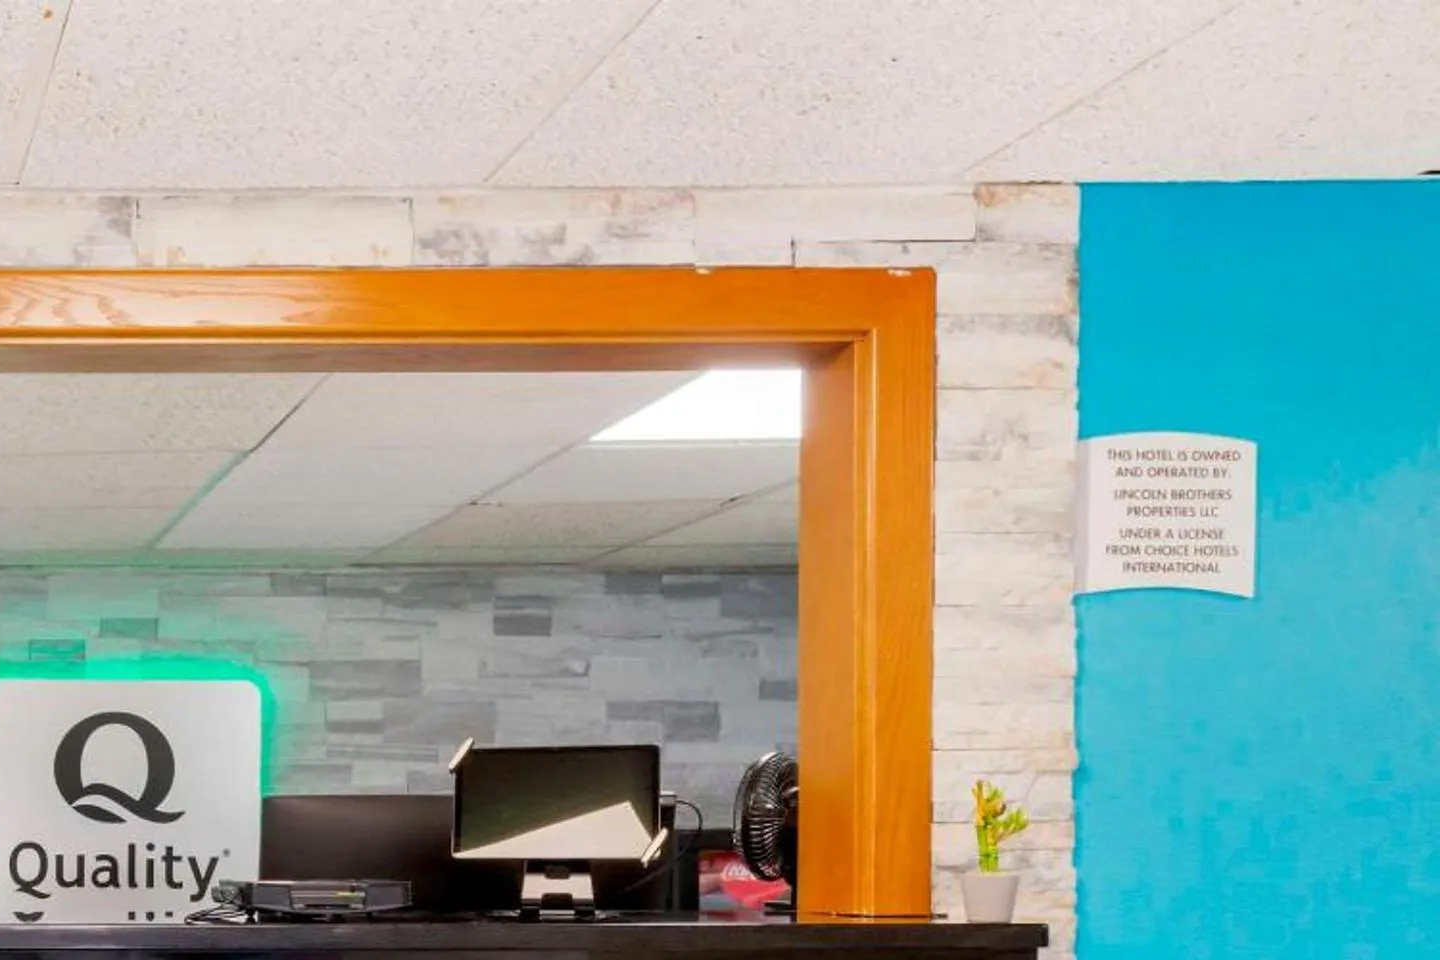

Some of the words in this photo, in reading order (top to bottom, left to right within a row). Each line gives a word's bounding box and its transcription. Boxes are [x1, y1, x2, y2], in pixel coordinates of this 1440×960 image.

[1107, 449, 1132, 461] THIS
[1136, 449, 1172, 461] HOTEL
[1177, 450, 1187, 461] IS
[1192, 450, 1241, 461] OWNED
[1115, 467, 1143, 478] AND
[1147, 467, 1209, 478] OPERATED
[1114, 489, 1166, 500] LINCOLN
[1170, 489, 1233, 500] BROTHERS
[1126, 506, 1196, 517] PROPERTIES
[1199, 507, 1218, 517] LLC
[1119, 528, 1160, 539] UNDER
[1165, 529, 1174, 539] A
[1177, 528, 1224, 540] LICENSE
[1105, 545, 1140, 555] FROM
[1144, 545, 1189, 556] CHOICE
[1194, 545, 1238, 556] HOTELS
[1122, 562, 1221, 573] INTERNATIONAL
[53, 711, 186, 824] Q
[9, 841, 219, 902] Quality
